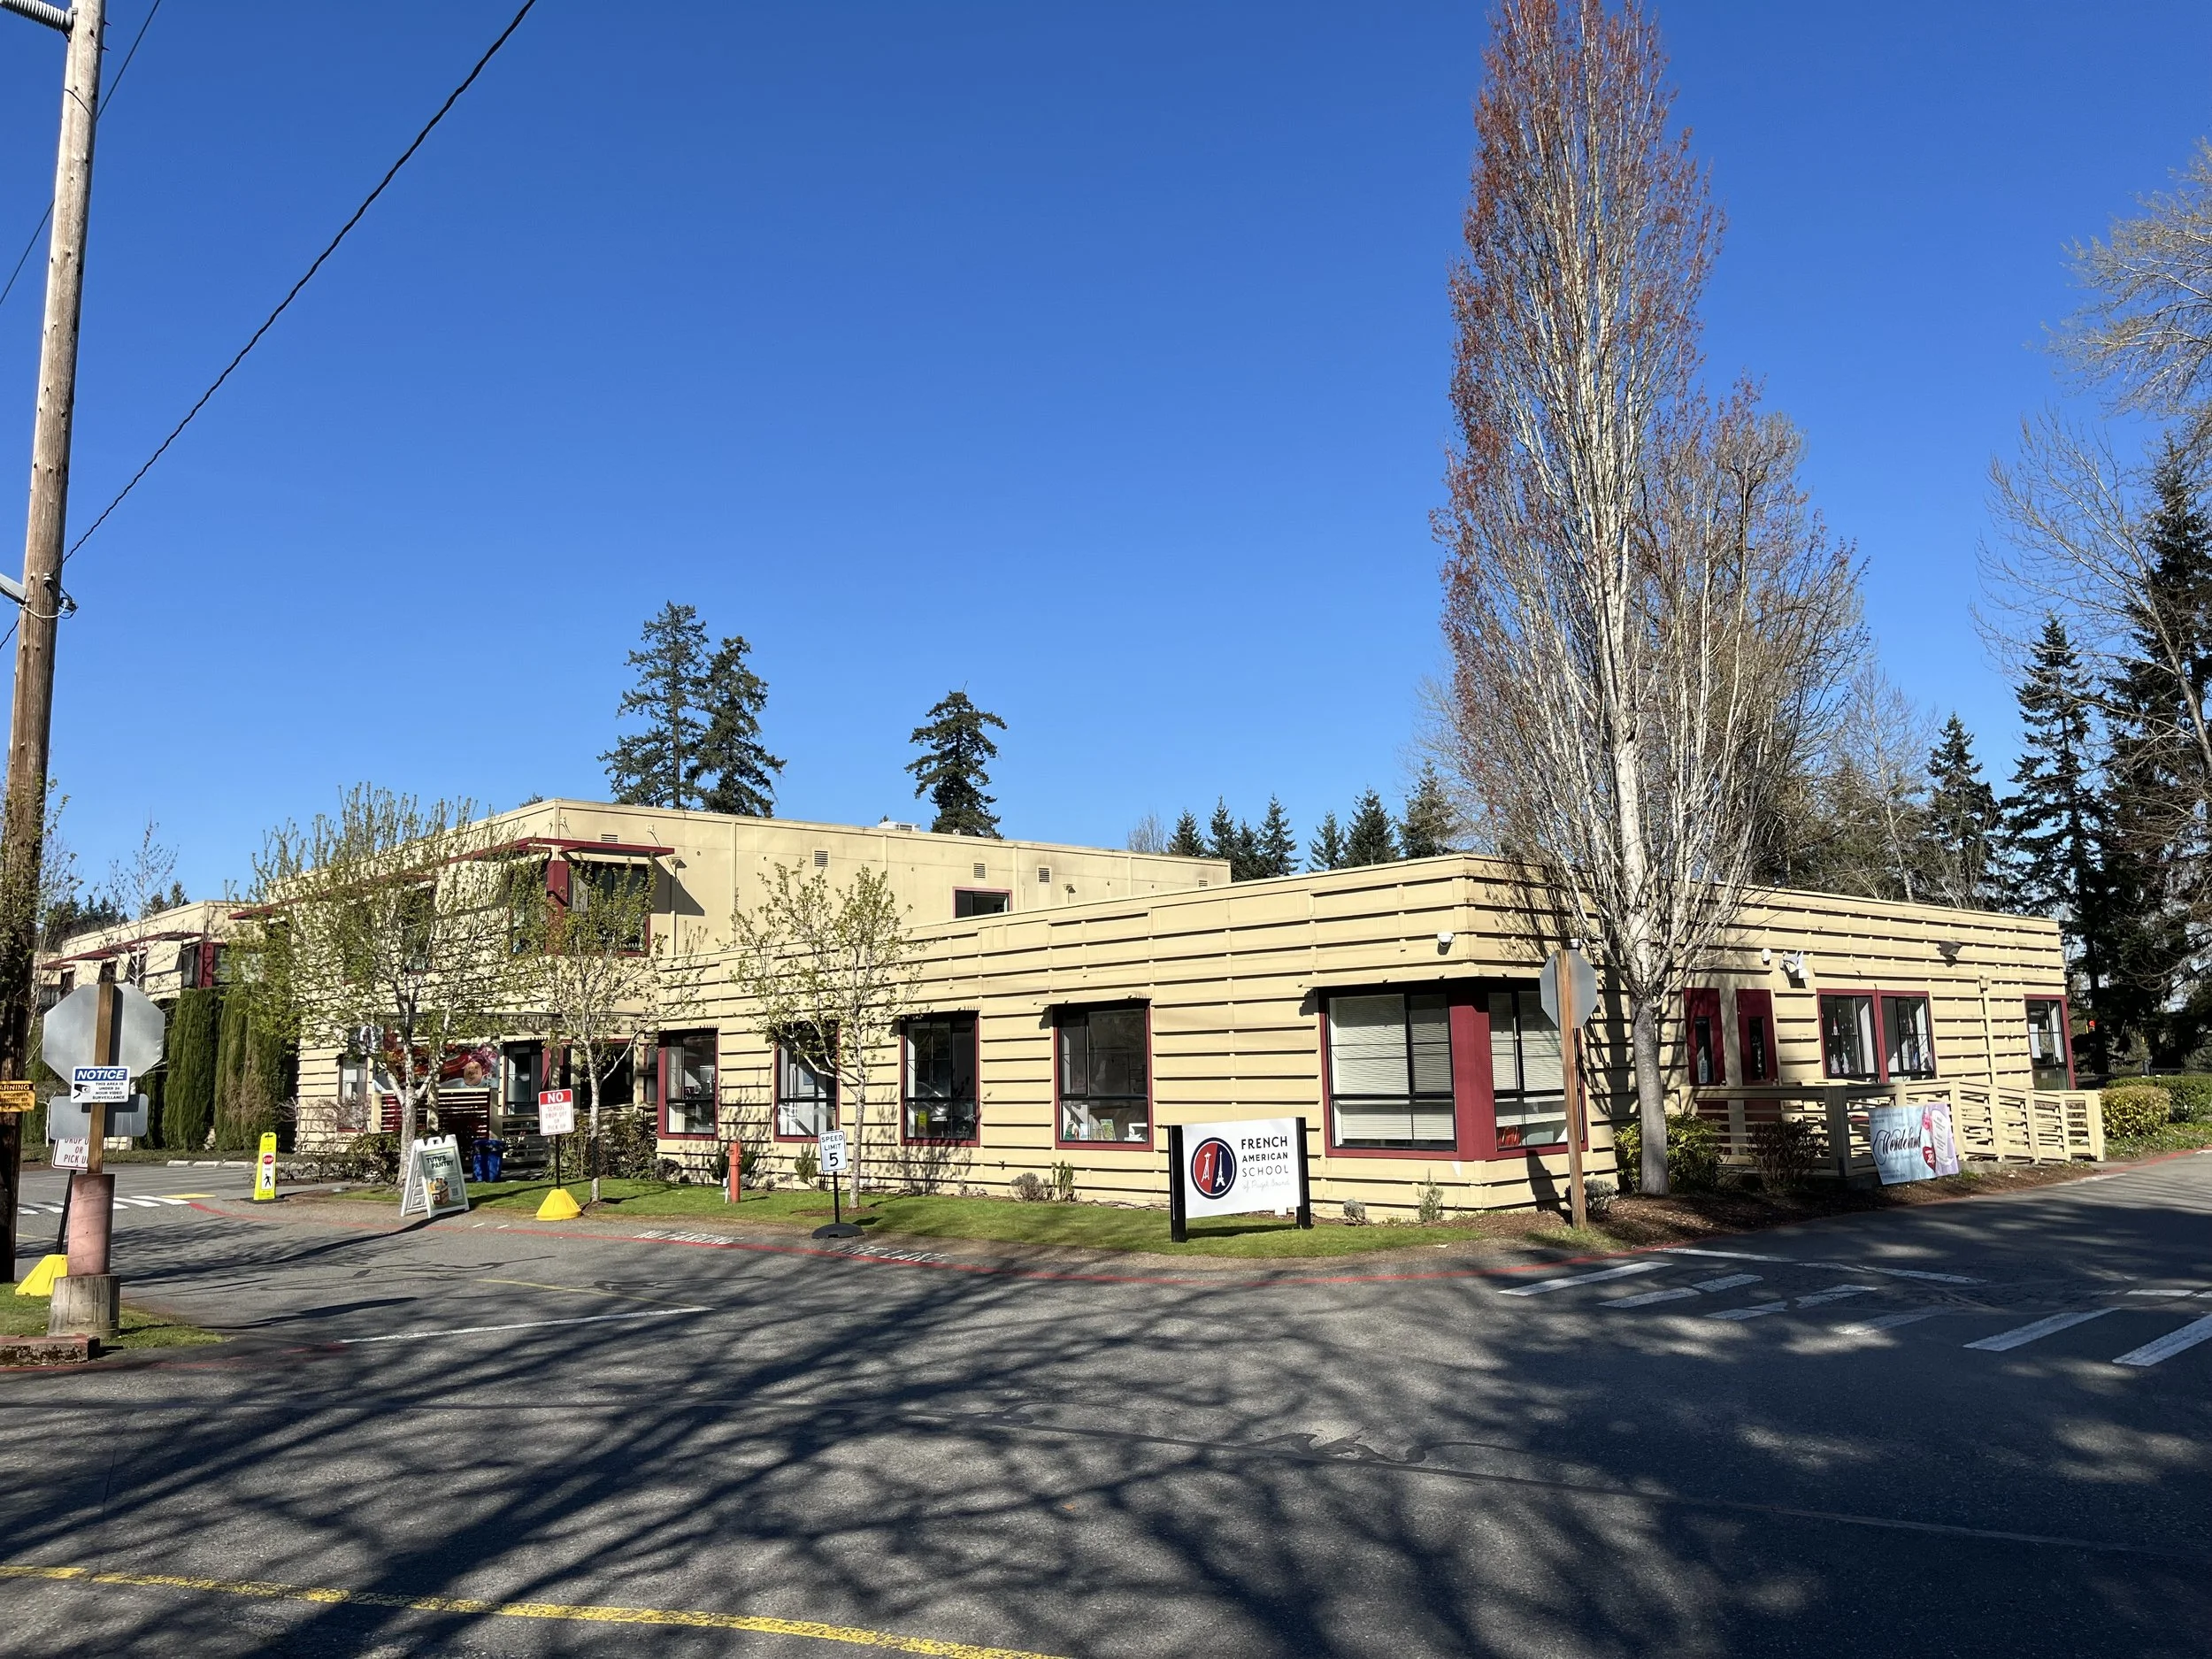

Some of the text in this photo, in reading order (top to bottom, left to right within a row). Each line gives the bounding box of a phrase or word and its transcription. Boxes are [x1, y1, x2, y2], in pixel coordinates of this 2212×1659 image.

[77, 1070, 125, 1079] NOTICE
[548, 1092, 565, 1103] NO
[1241, 1136, 1287, 1150] FRENCH
[1873, 1126, 1922, 1166] Wondeland
[830, 1152, 838, 1166] 5
[1242, 1152, 1288, 1163] AMERICAN
[432, 1160, 454, 1169] PANTRY
[1242, 1164, 1288, 1177] SCHOOL
